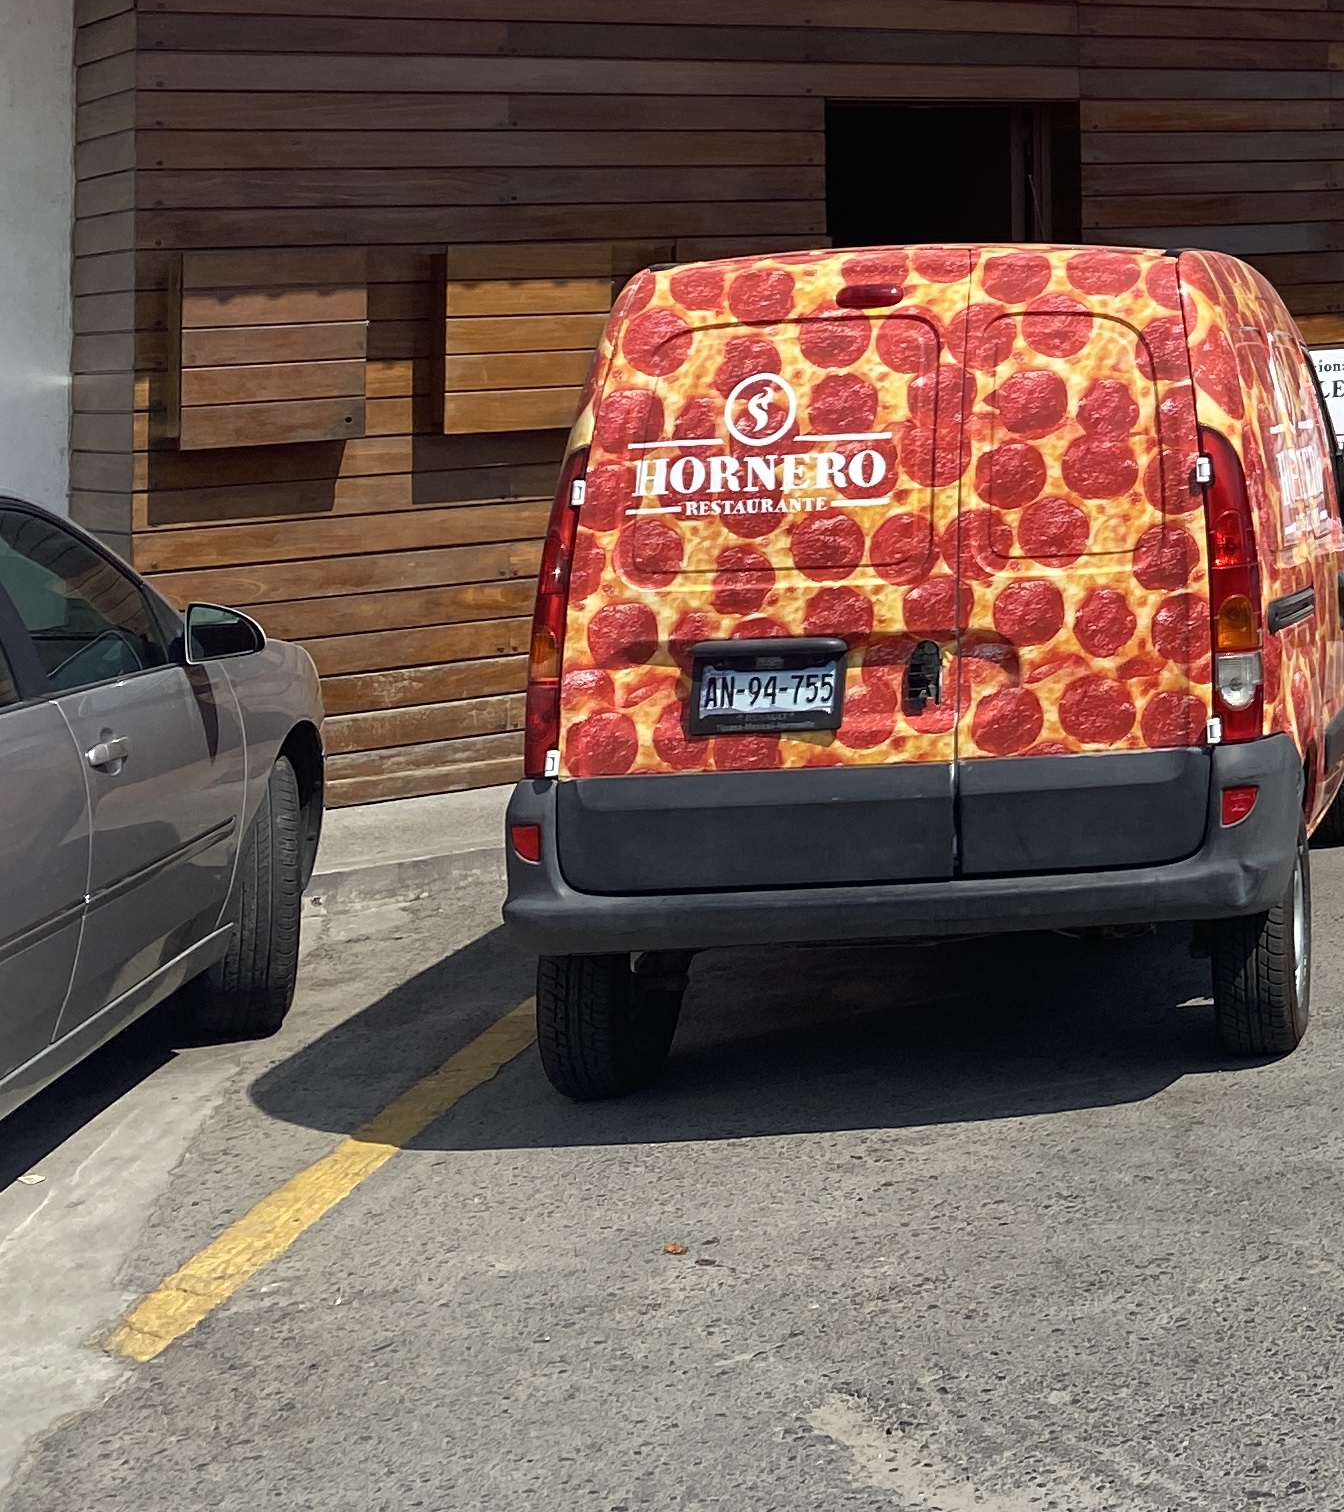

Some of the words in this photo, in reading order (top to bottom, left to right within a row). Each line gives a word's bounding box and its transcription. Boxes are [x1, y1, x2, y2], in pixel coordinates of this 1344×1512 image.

[631, 449, 887, 497] HORNERO
[685, 496, 828, 517] RESTAURANTE
[704, 673, 834, 708] AN-94-755
